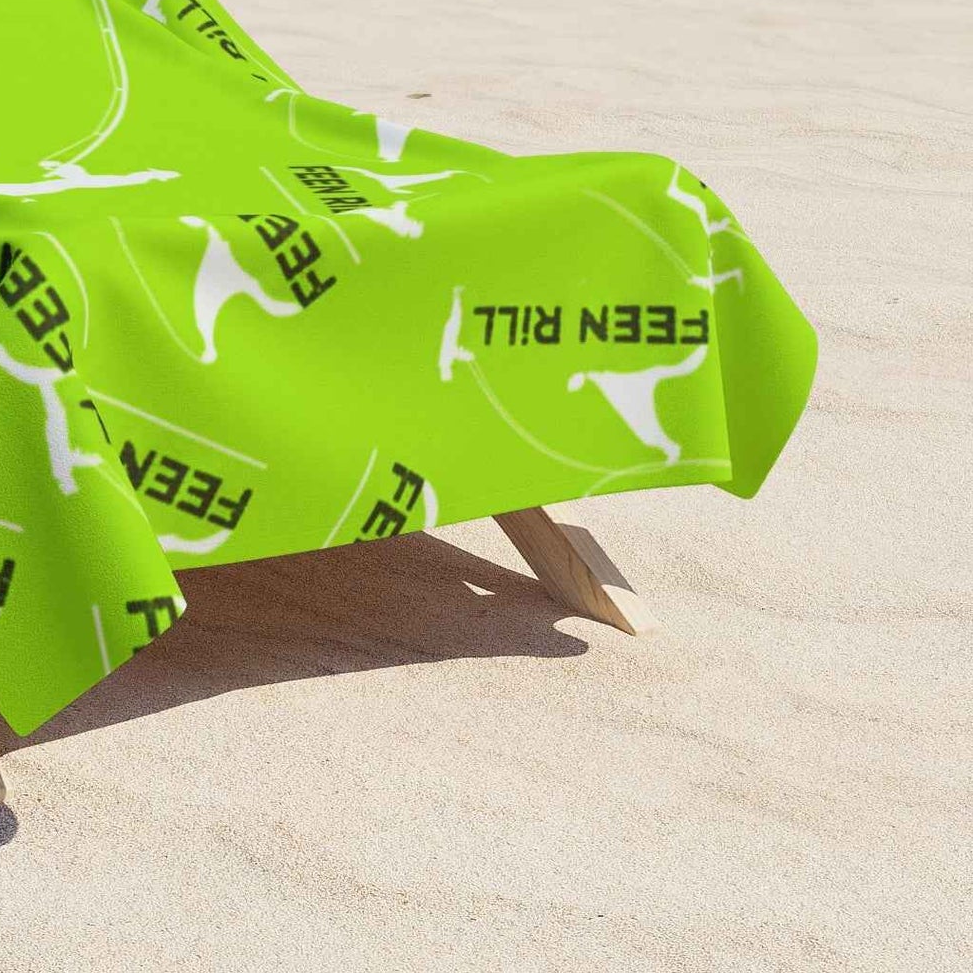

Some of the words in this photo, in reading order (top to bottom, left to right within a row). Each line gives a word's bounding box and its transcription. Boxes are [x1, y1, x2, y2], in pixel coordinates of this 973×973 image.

[288, 165, 360, 194] FEEN
[237, 214, 338, 309] FEE
[578, 305, 709, 345] FEEN
[119, 440, 253, 530] FEEN
[354, 461, 425, 543] FE
